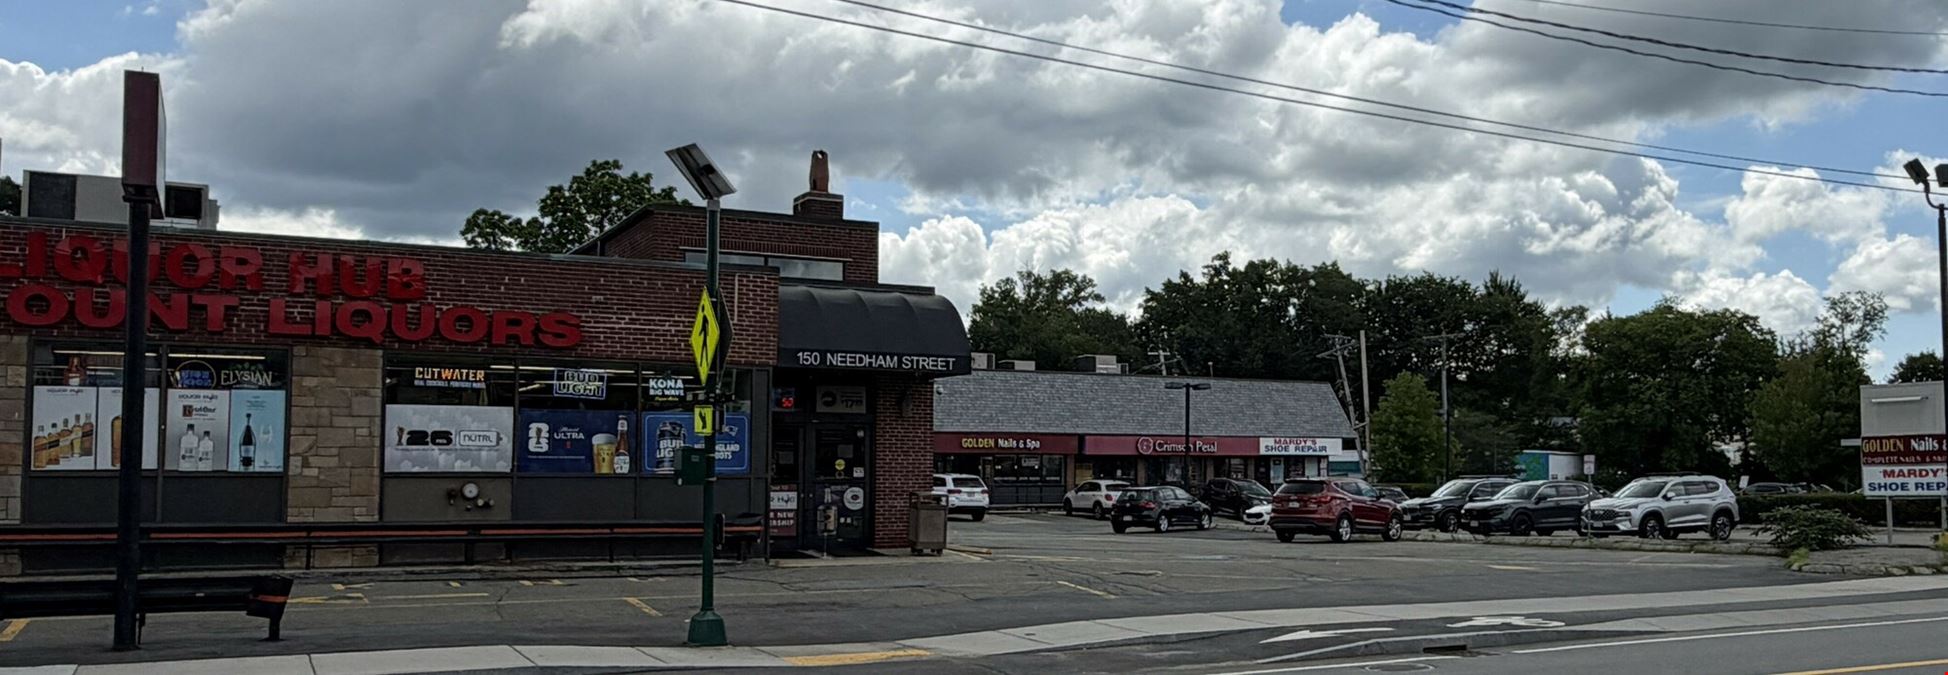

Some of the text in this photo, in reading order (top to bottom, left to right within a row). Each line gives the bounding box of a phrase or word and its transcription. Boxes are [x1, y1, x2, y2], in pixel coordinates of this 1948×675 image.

[288, 250, 426, 300] HUB
[268, 297, 584, 347] LIQUORS
[796, 351, 956, 371] 150 NEEDHAM STREET
[220, 369, 273, 387] ELYSIAN
[415, 367, 485, 381] CUTWATER
[564, 371, 599, 383] BUD
[556, 382, 602, 397] LIGHT
[649, 378, 684, 389] KONA
[553, 432, 585, 440] ULTRA
[1273, 438, 1318, 446] MARDY'S
[961, 438, 1041, 449] GOLDEN Nails & Spa
[1196, 440, 1217, 452] Petal
[1264, 445, 1328, 453] SHOE REPAIR
[1862, 438, 1904, 453] GOLDEN
[1910, 436, 1939, 451] Nails
[656, 448, 674, 458] LIG
[1882, 468, 1946, 479] MARDY'
[1868, 482, 1948, 492] SHOE REP
